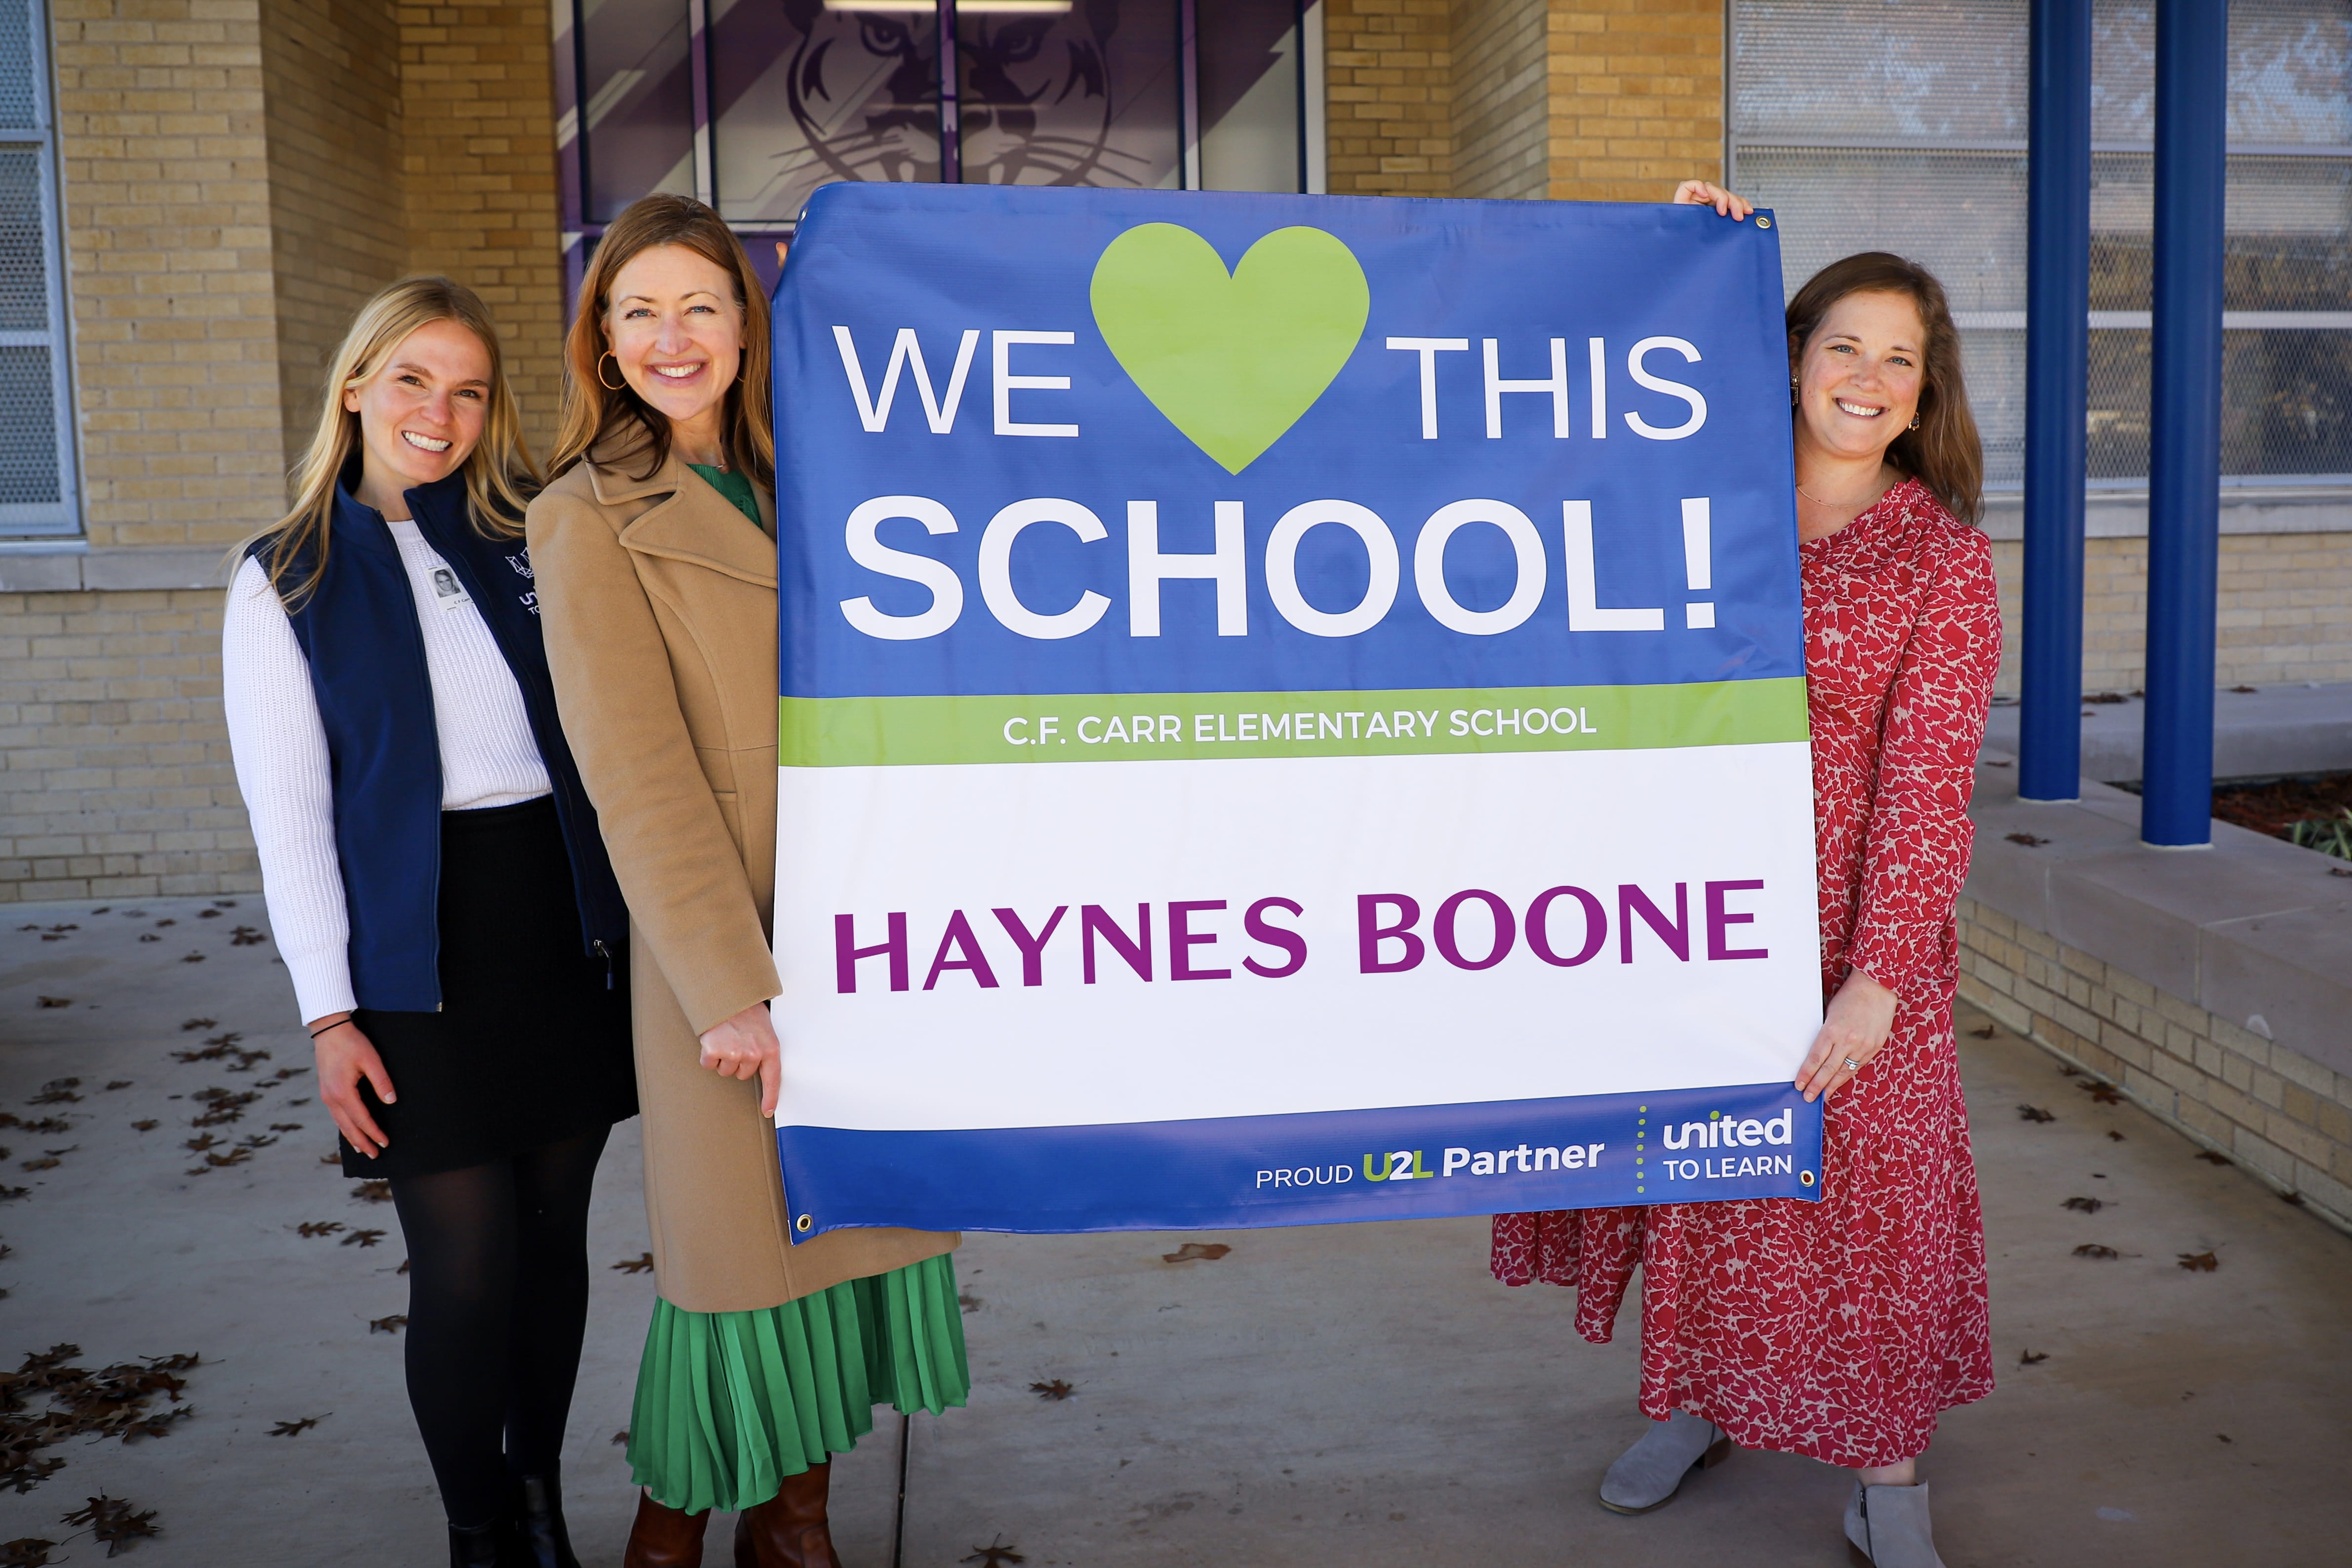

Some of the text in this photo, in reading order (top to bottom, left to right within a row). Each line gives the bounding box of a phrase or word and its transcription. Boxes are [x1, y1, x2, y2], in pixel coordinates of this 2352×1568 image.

[831, 325, 1708, 441] WE THIS
[839, 495, 1716, 641] SCHOOL!
[1002, 706, 1599, 747] C.F. CARR ELEMENTARY SCHOOL
[834, 879, 1769, 994] HAYNES BOONE
[1663, 1108, 1793, 1151] united
[1256, 1142, 1605, 1189] PROUD U2L Partner
[1663, 1154, 1792, 1181] TO LEARN
